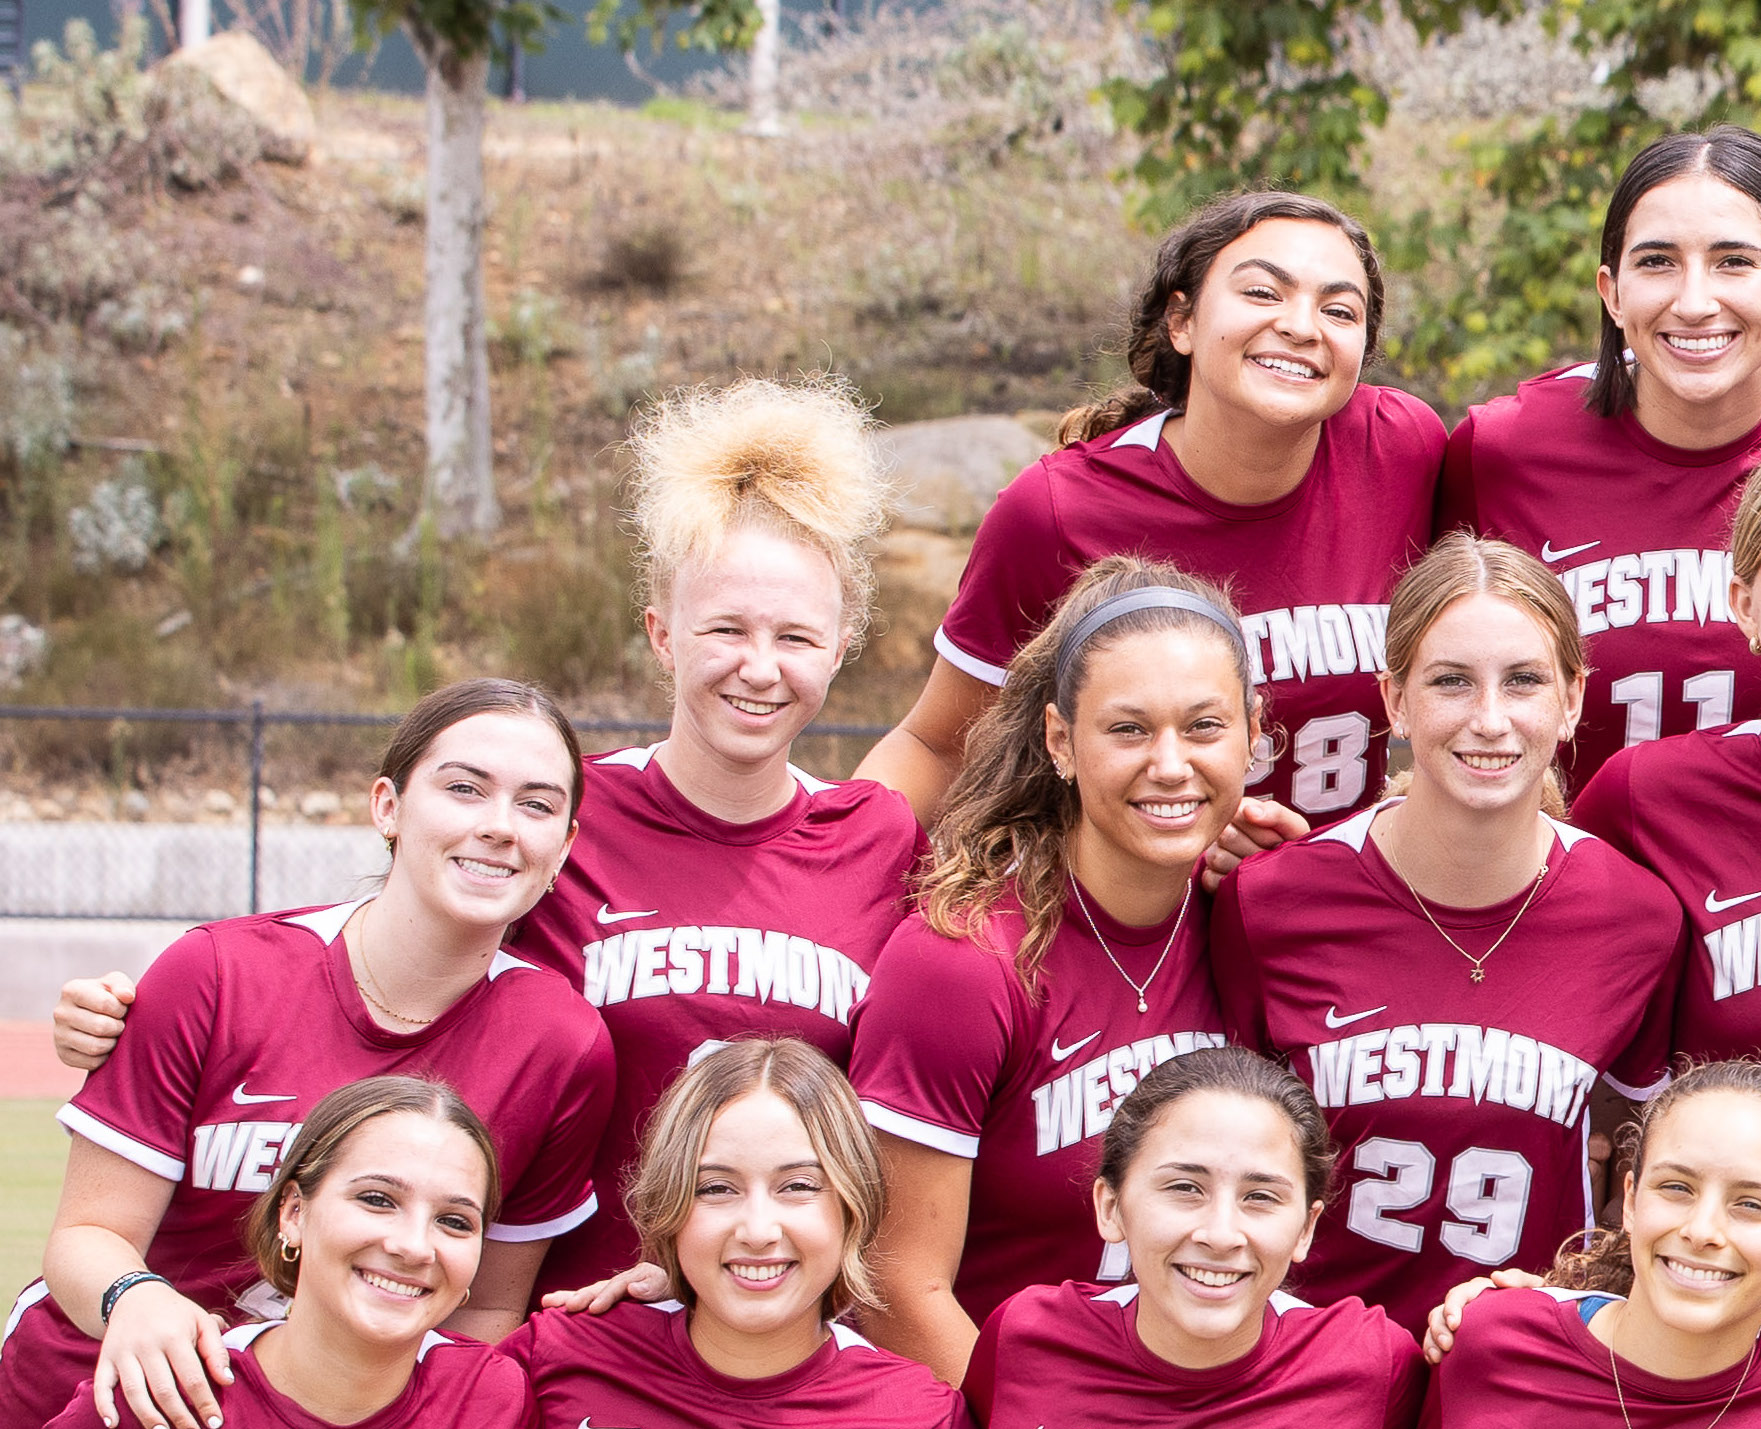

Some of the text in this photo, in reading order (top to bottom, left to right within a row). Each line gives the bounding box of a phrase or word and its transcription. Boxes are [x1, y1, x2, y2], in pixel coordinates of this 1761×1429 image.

[1556, 547, 1737, 638] ESTM
[1307, 1022, 1599, 1130] WESTMONT
[1346, 1135, 1534, 1267] 29
